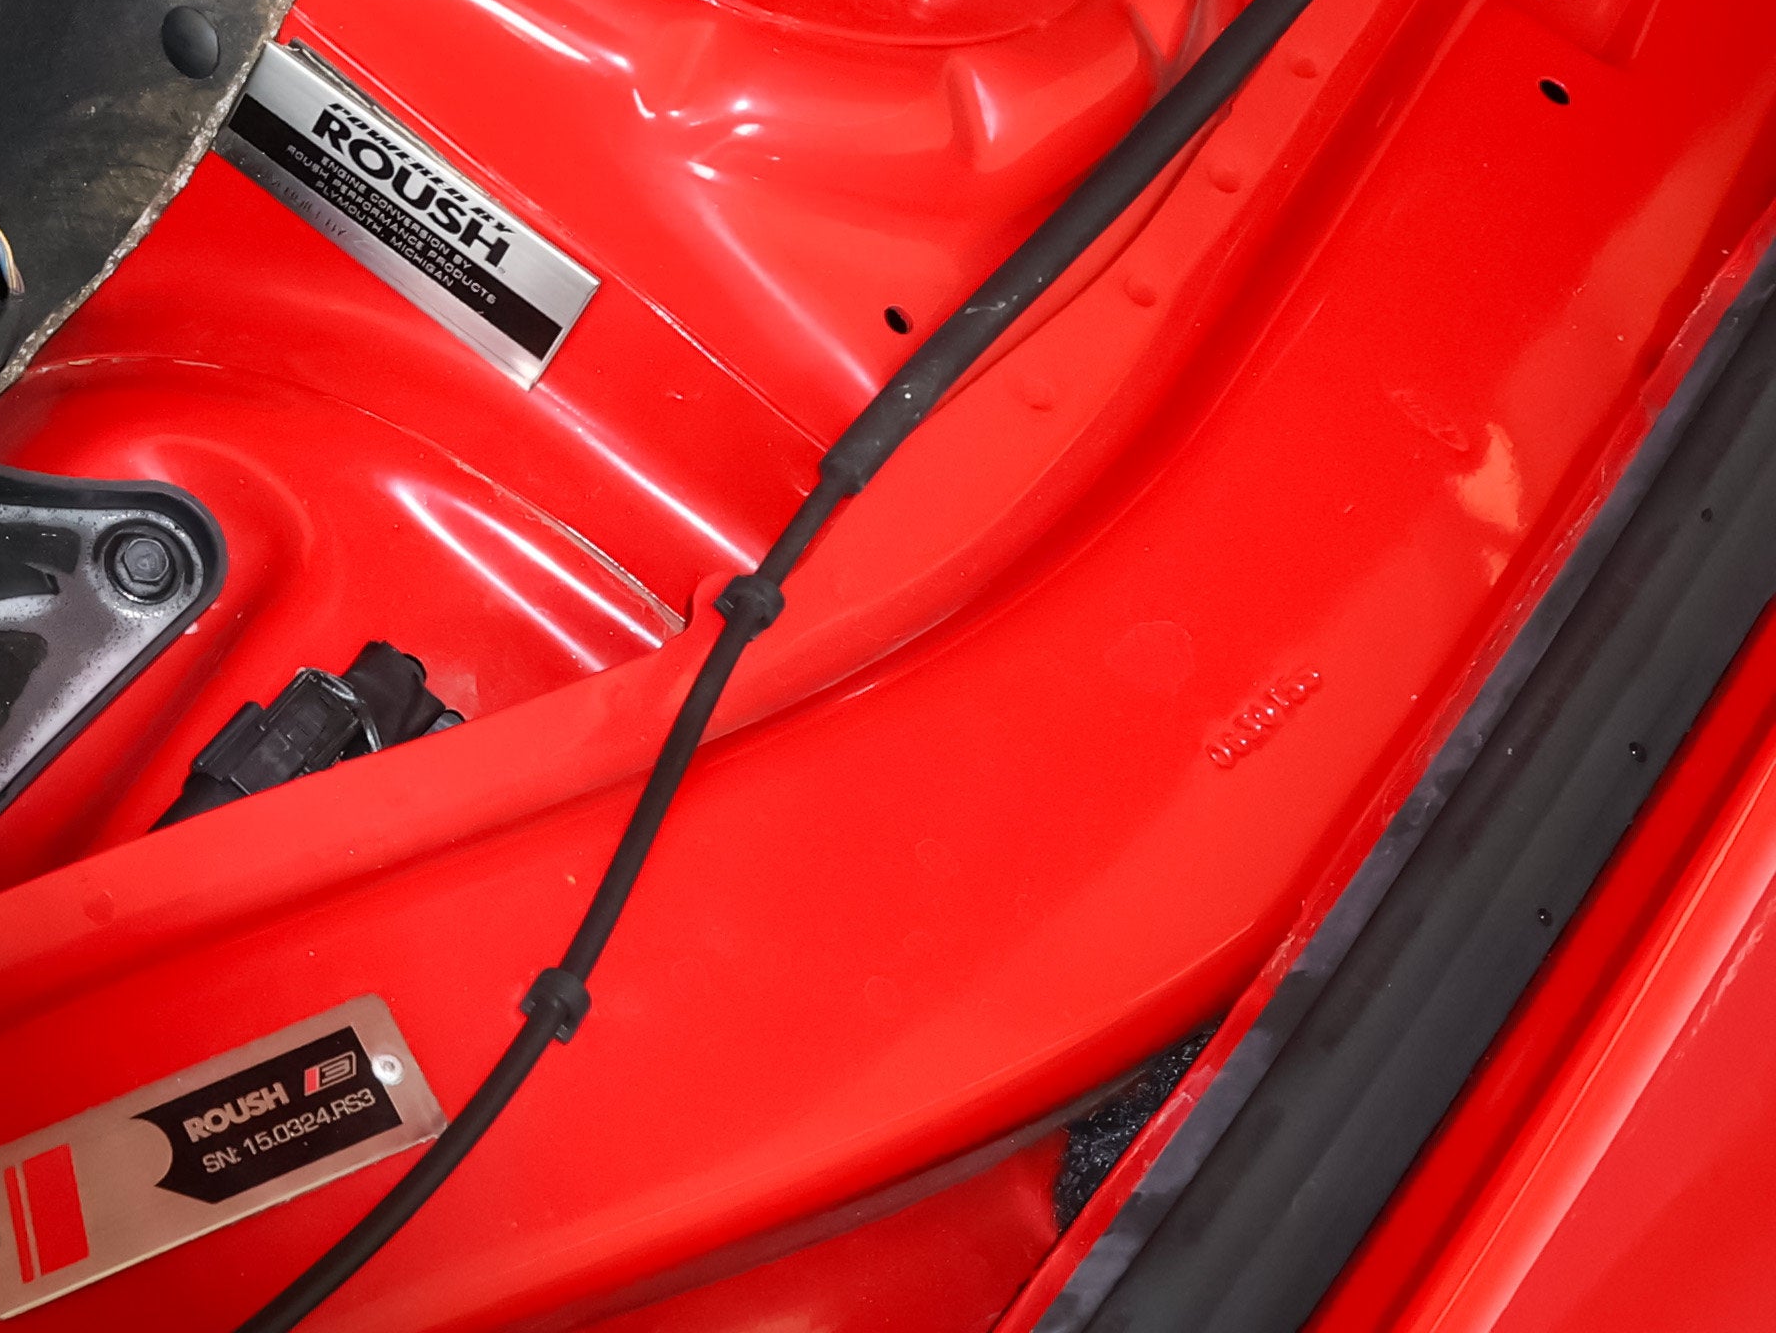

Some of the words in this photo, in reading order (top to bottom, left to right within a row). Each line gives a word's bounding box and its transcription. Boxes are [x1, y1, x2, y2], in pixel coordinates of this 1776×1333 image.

[285, 145, 330, 181] ROUSH
[334, 181, 426, 252] PERFORMANCE
[426, 250, 498, 305] PRODUCTS
[308, 109, 513, 269] ROUSH
[320, 157, 368, 195] ENGINE
[368, 192, 452, 256] CONVERSION
[453, 254, 473, 272] BY
[328, 103, 469, 201] POWERED
[479, 214, 516, 233] BY
[388, 236, 455, 287] MICHIGAN
[181, 1082, 290, 1143] ROUSH
[202, 1142, 243, 1175] SN:
[243, 1088, 377, 1158] 15.0324.RS3
